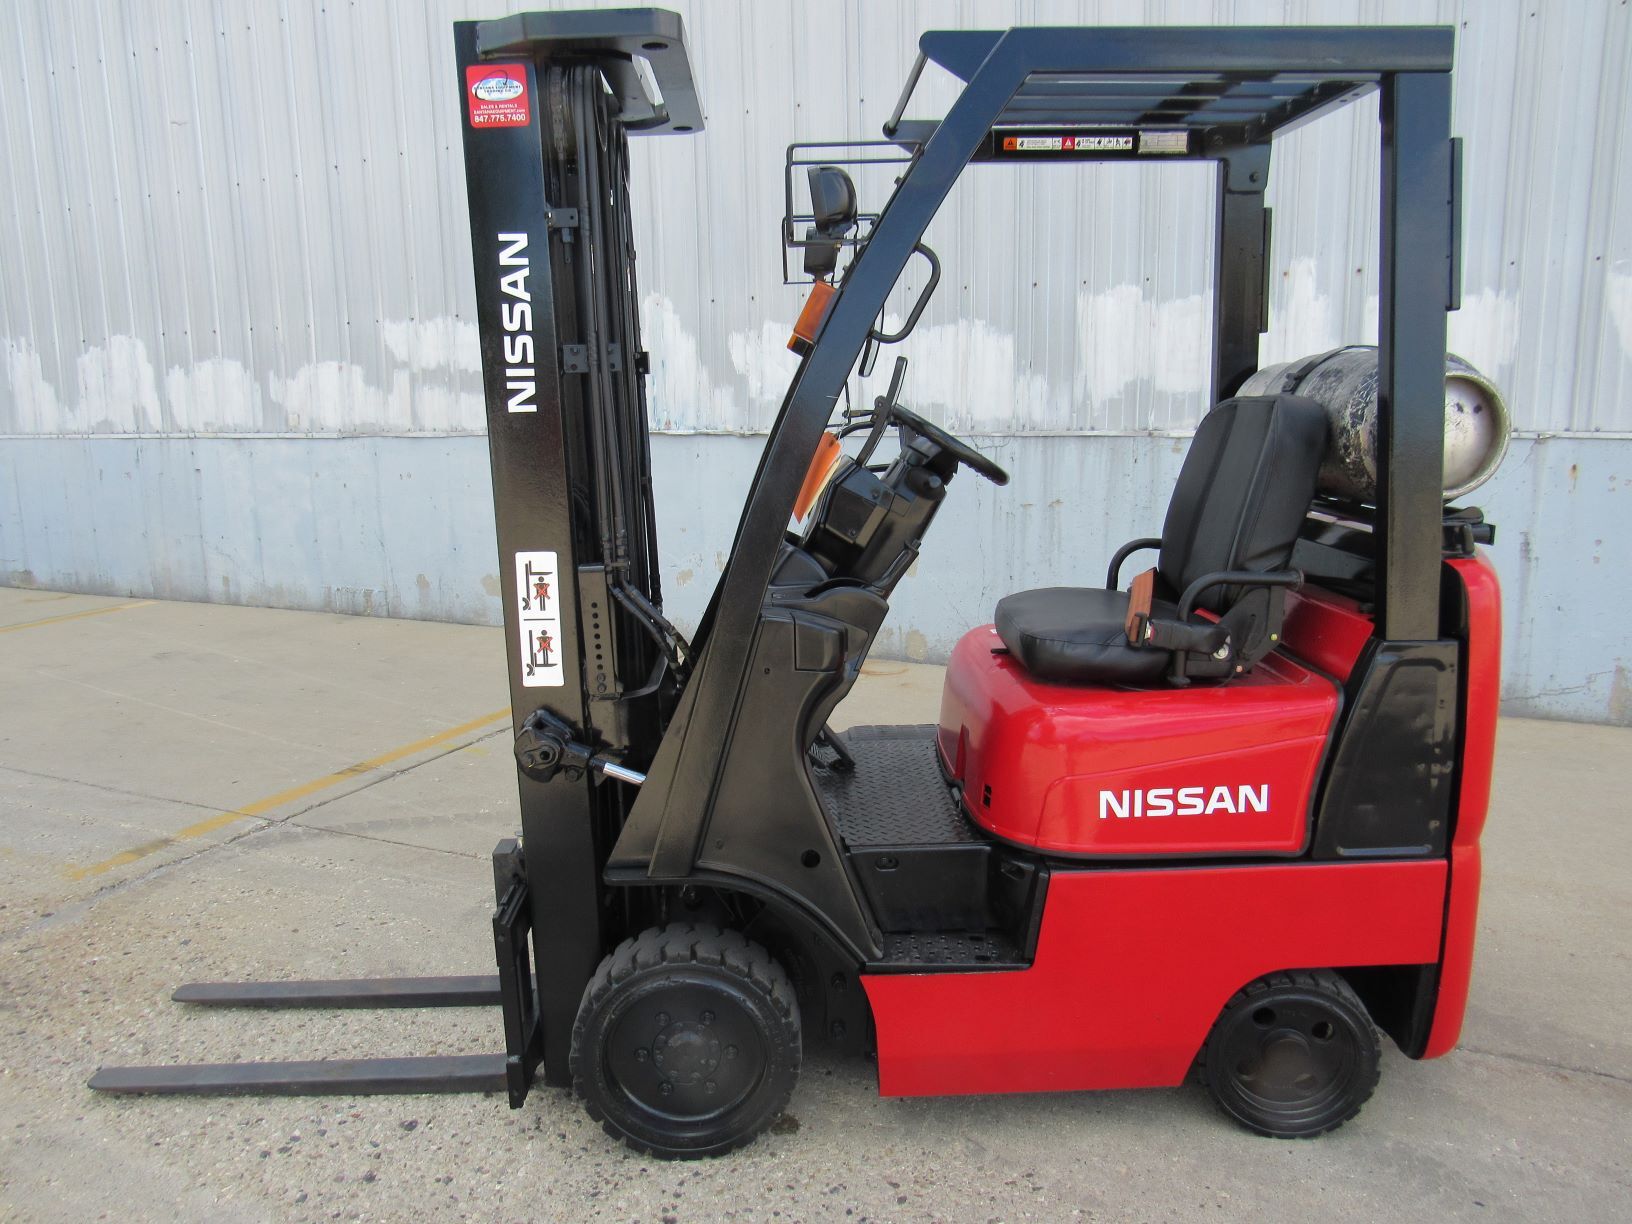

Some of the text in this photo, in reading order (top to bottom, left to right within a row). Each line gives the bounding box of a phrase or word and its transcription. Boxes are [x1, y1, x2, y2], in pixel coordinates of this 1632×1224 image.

[474, 113, 526, 123] 847.775.7400
[498, 232, 538, 414] NISSAN
[1099, 783, 1269, 819] NISSAN
